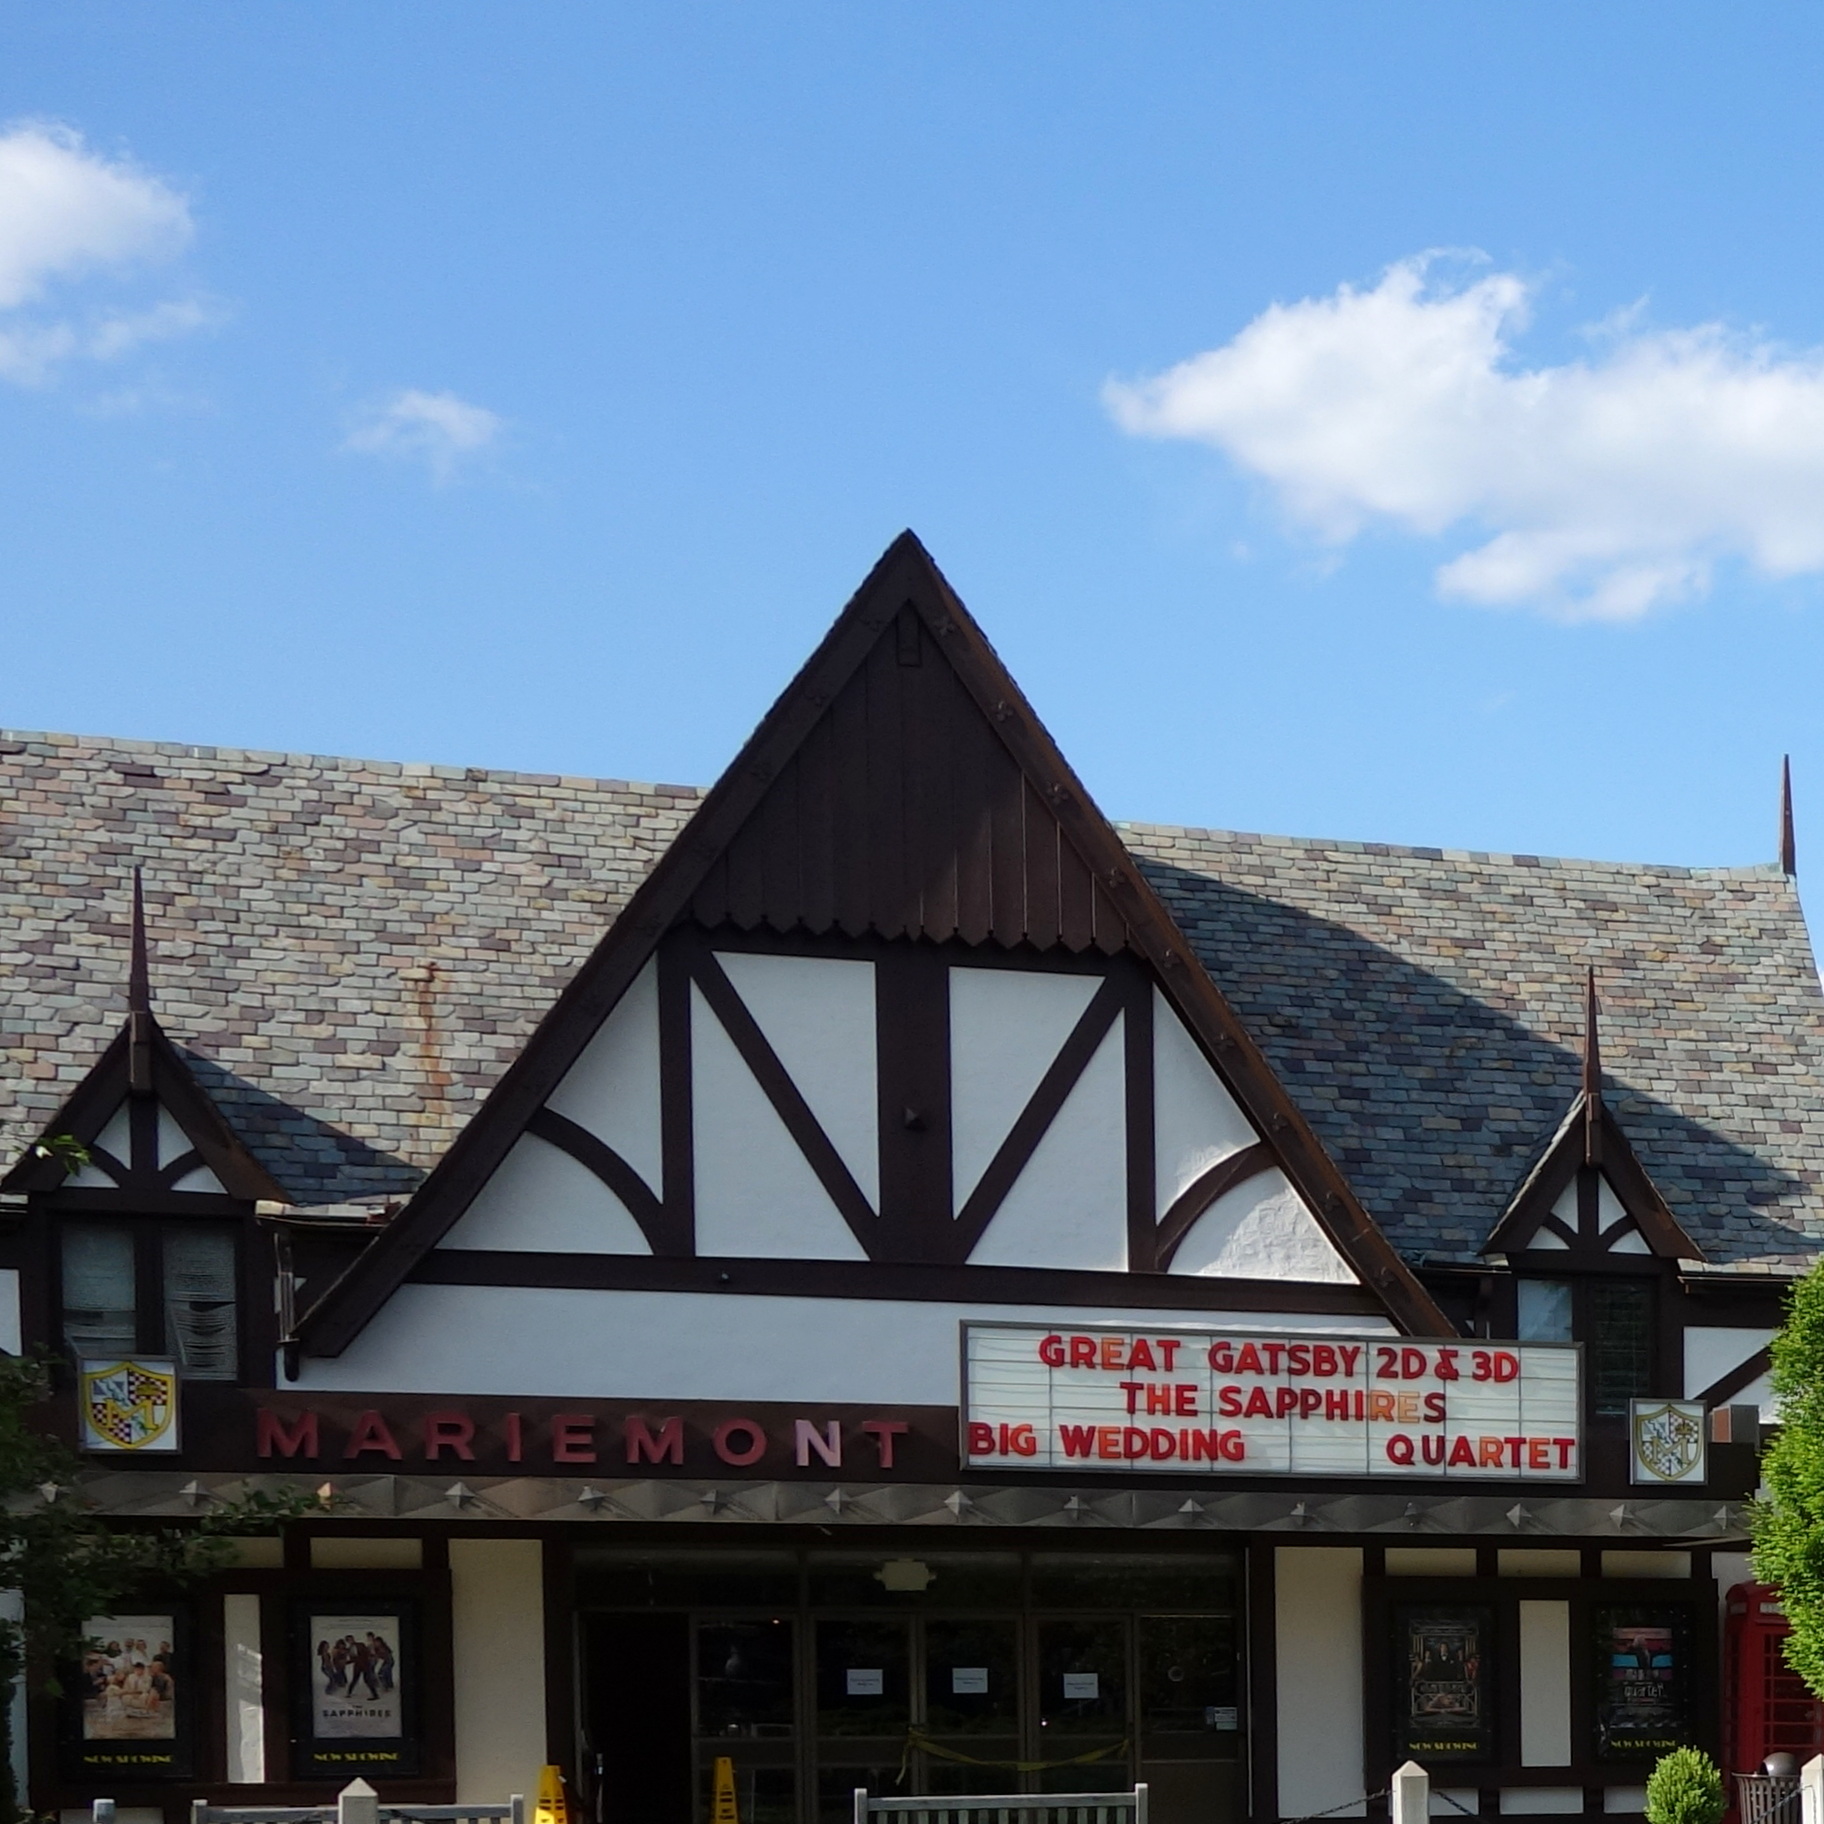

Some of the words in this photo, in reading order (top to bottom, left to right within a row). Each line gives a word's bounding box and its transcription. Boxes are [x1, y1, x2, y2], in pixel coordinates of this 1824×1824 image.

[1038, 1335, 1181, 1371] GREAT
[1207, 1341, 1361, 1377] GATSBY
[1376, 1347, 1427, 1380] 2D
[1434, 1350, 1459, 1381] &
[1472, 1351, 1519, 1382] 3D
[1119, 1382, 1198, 1416] THE
[1219, 1385, 1447, 1423] SAPPHIRES
[257, 1407, 908, 1468] MARIEMONT
[968, 1422, 1036, 1456] BIG
[1059, 1425, 1245, 1461] WEDDING
[1386, 1434, 1575, 1469] QUARTET
[322, 1709, 392, 1718] SAPPHIRES
